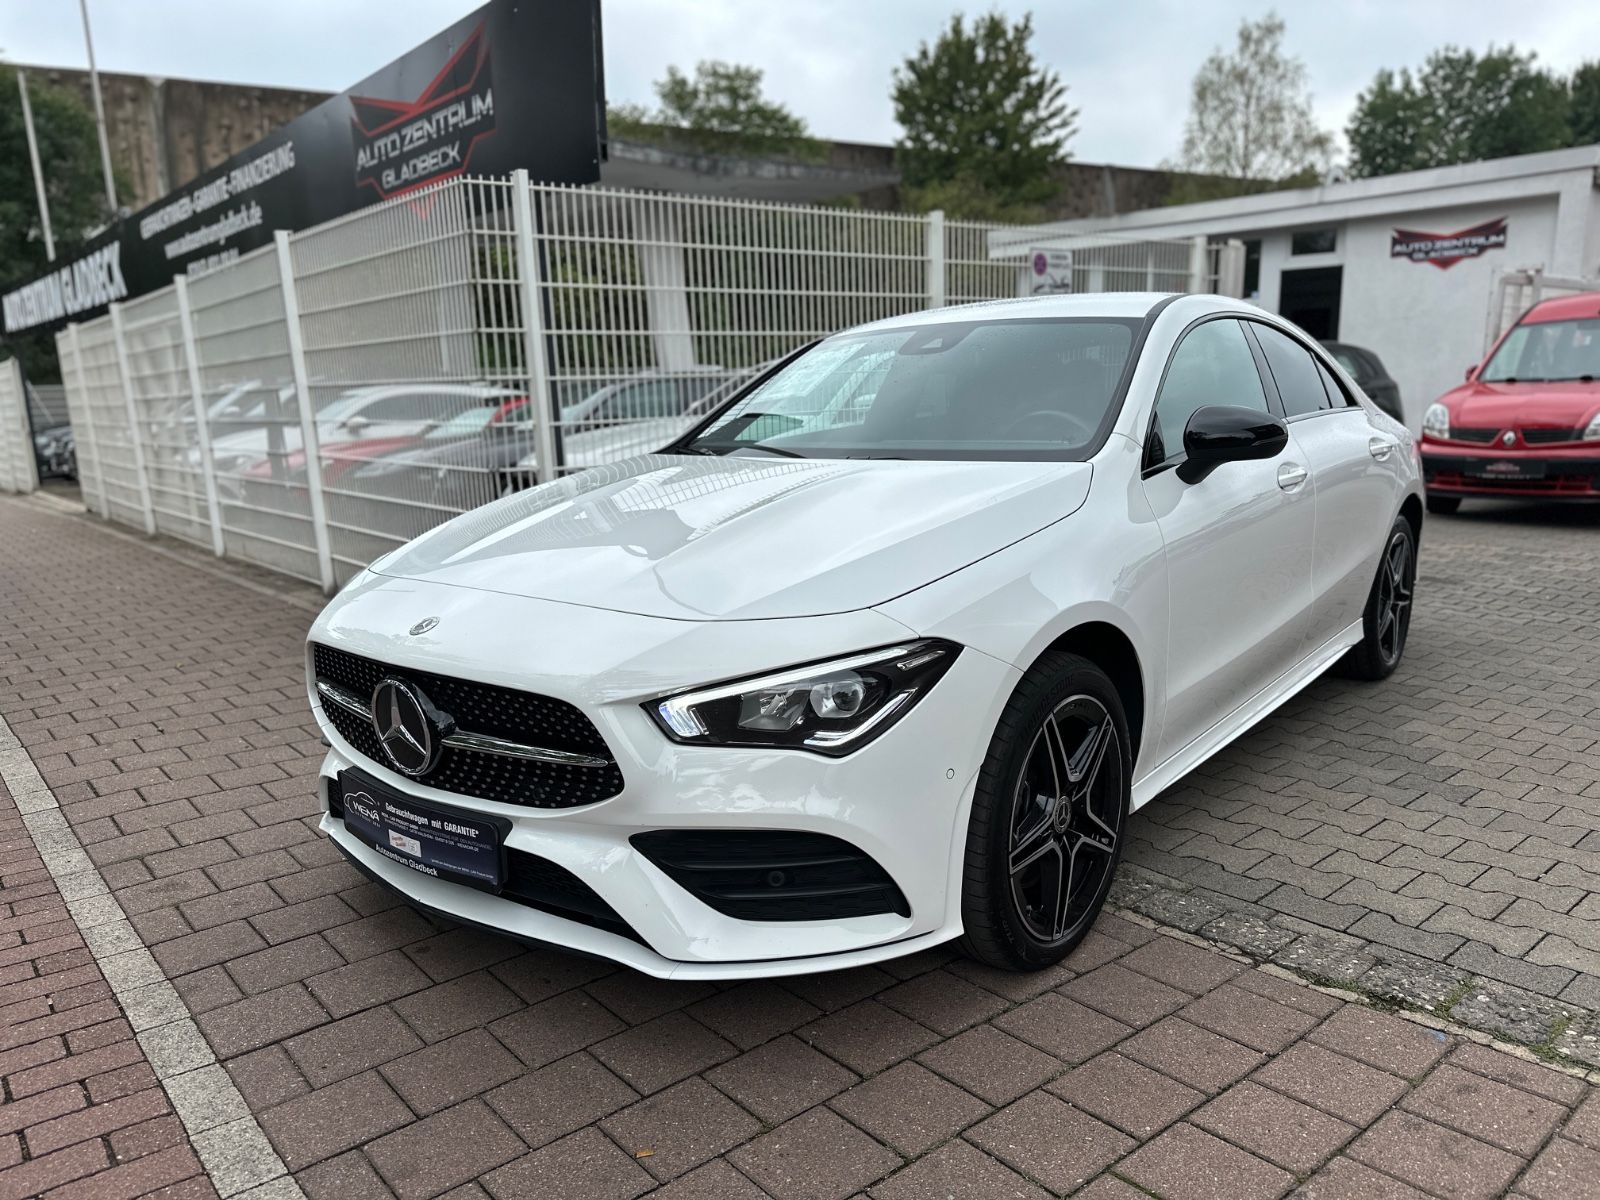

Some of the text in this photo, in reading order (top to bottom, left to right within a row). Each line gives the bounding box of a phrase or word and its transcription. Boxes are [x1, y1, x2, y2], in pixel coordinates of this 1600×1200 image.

[356, 88, 494, 171] AUTO ZENTRUM
[382, 140, 461, 189] GLADBECK
[1393, 234, 1505, 254] AUTO ZENTRUM
[385, 802, 429, 825] Gebrauchtwagen
[431, 819, 442, 830] mit
[375, 843, 409, 866] Autozentrum
[408, 858, 439, 876] Gladbeck
